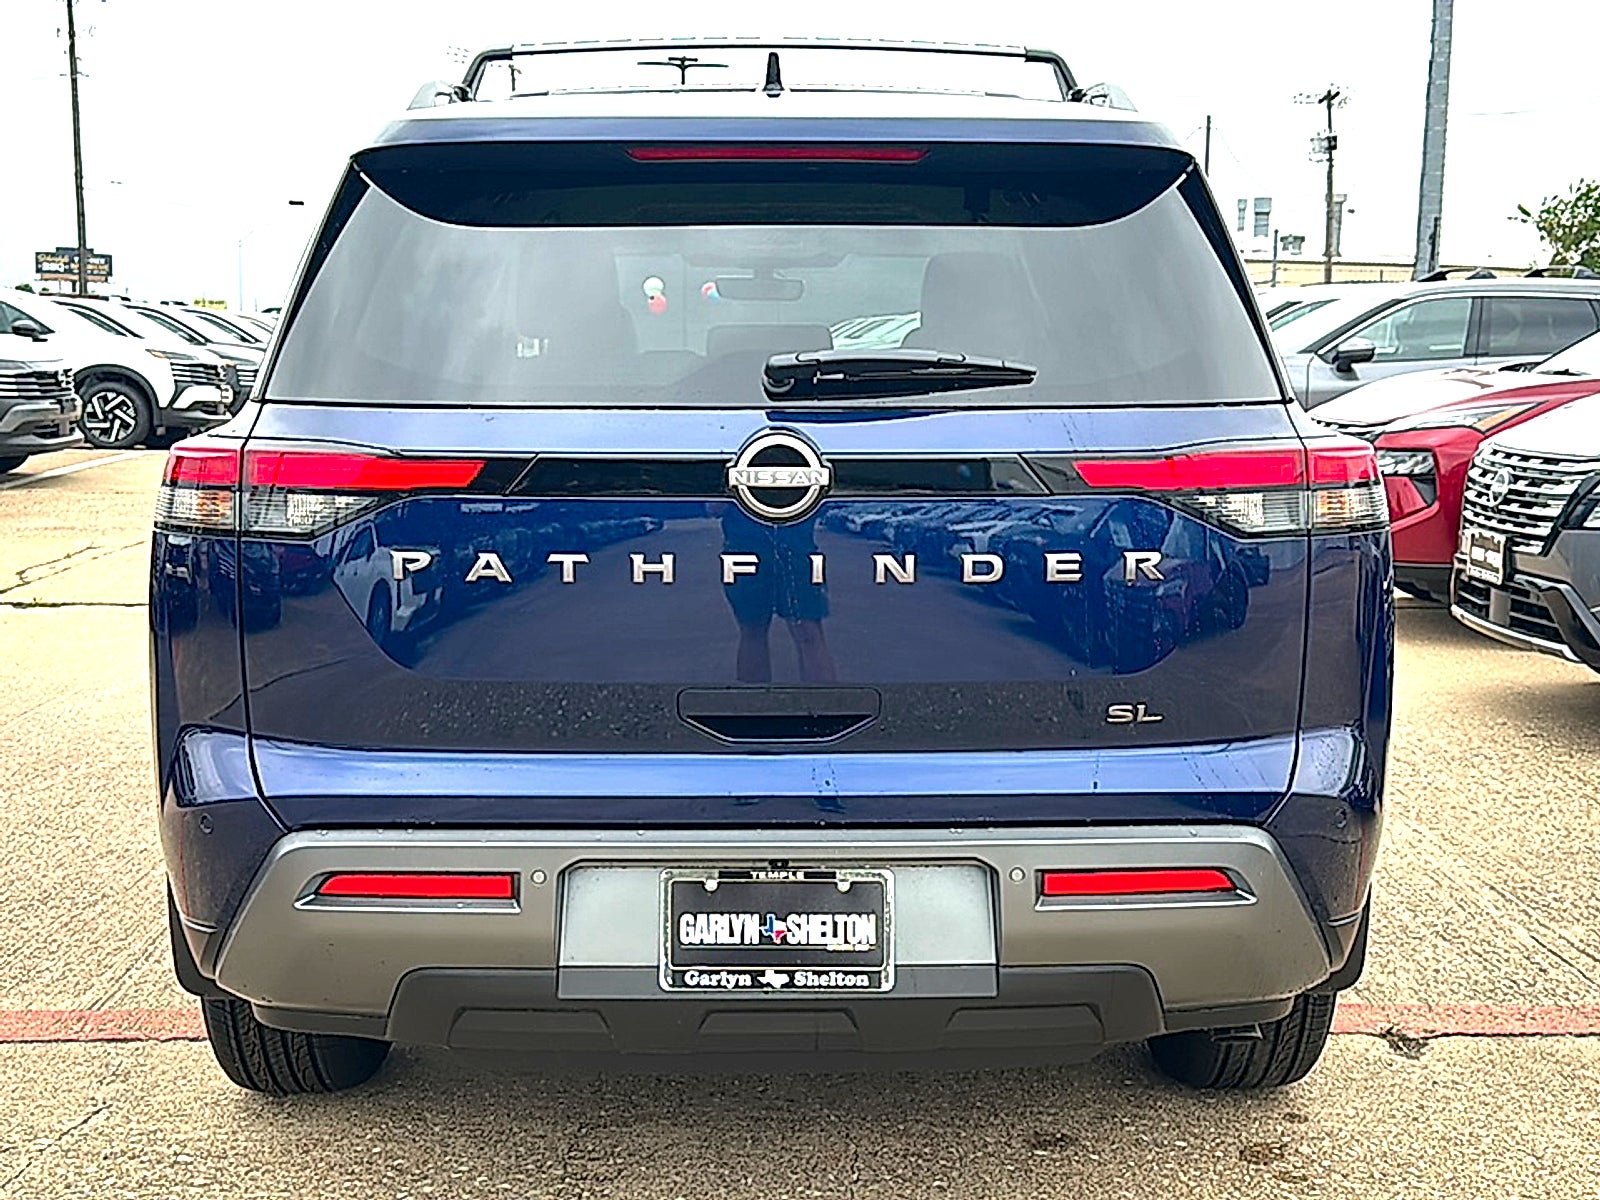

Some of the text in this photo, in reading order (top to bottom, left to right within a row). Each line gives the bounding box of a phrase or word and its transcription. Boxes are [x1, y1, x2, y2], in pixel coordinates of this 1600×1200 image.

[732, 469, 824, 486] NISSAN
[390, 550, 1165, 584] PATHFINDER
[1106, 704, 1163, 722] SL
[750, 871, 805, 880] TEMPLE
[679, 913, 877, 945] GARLYN SHELTON
[684, 970, 870, 989] Garlyn Shelton
